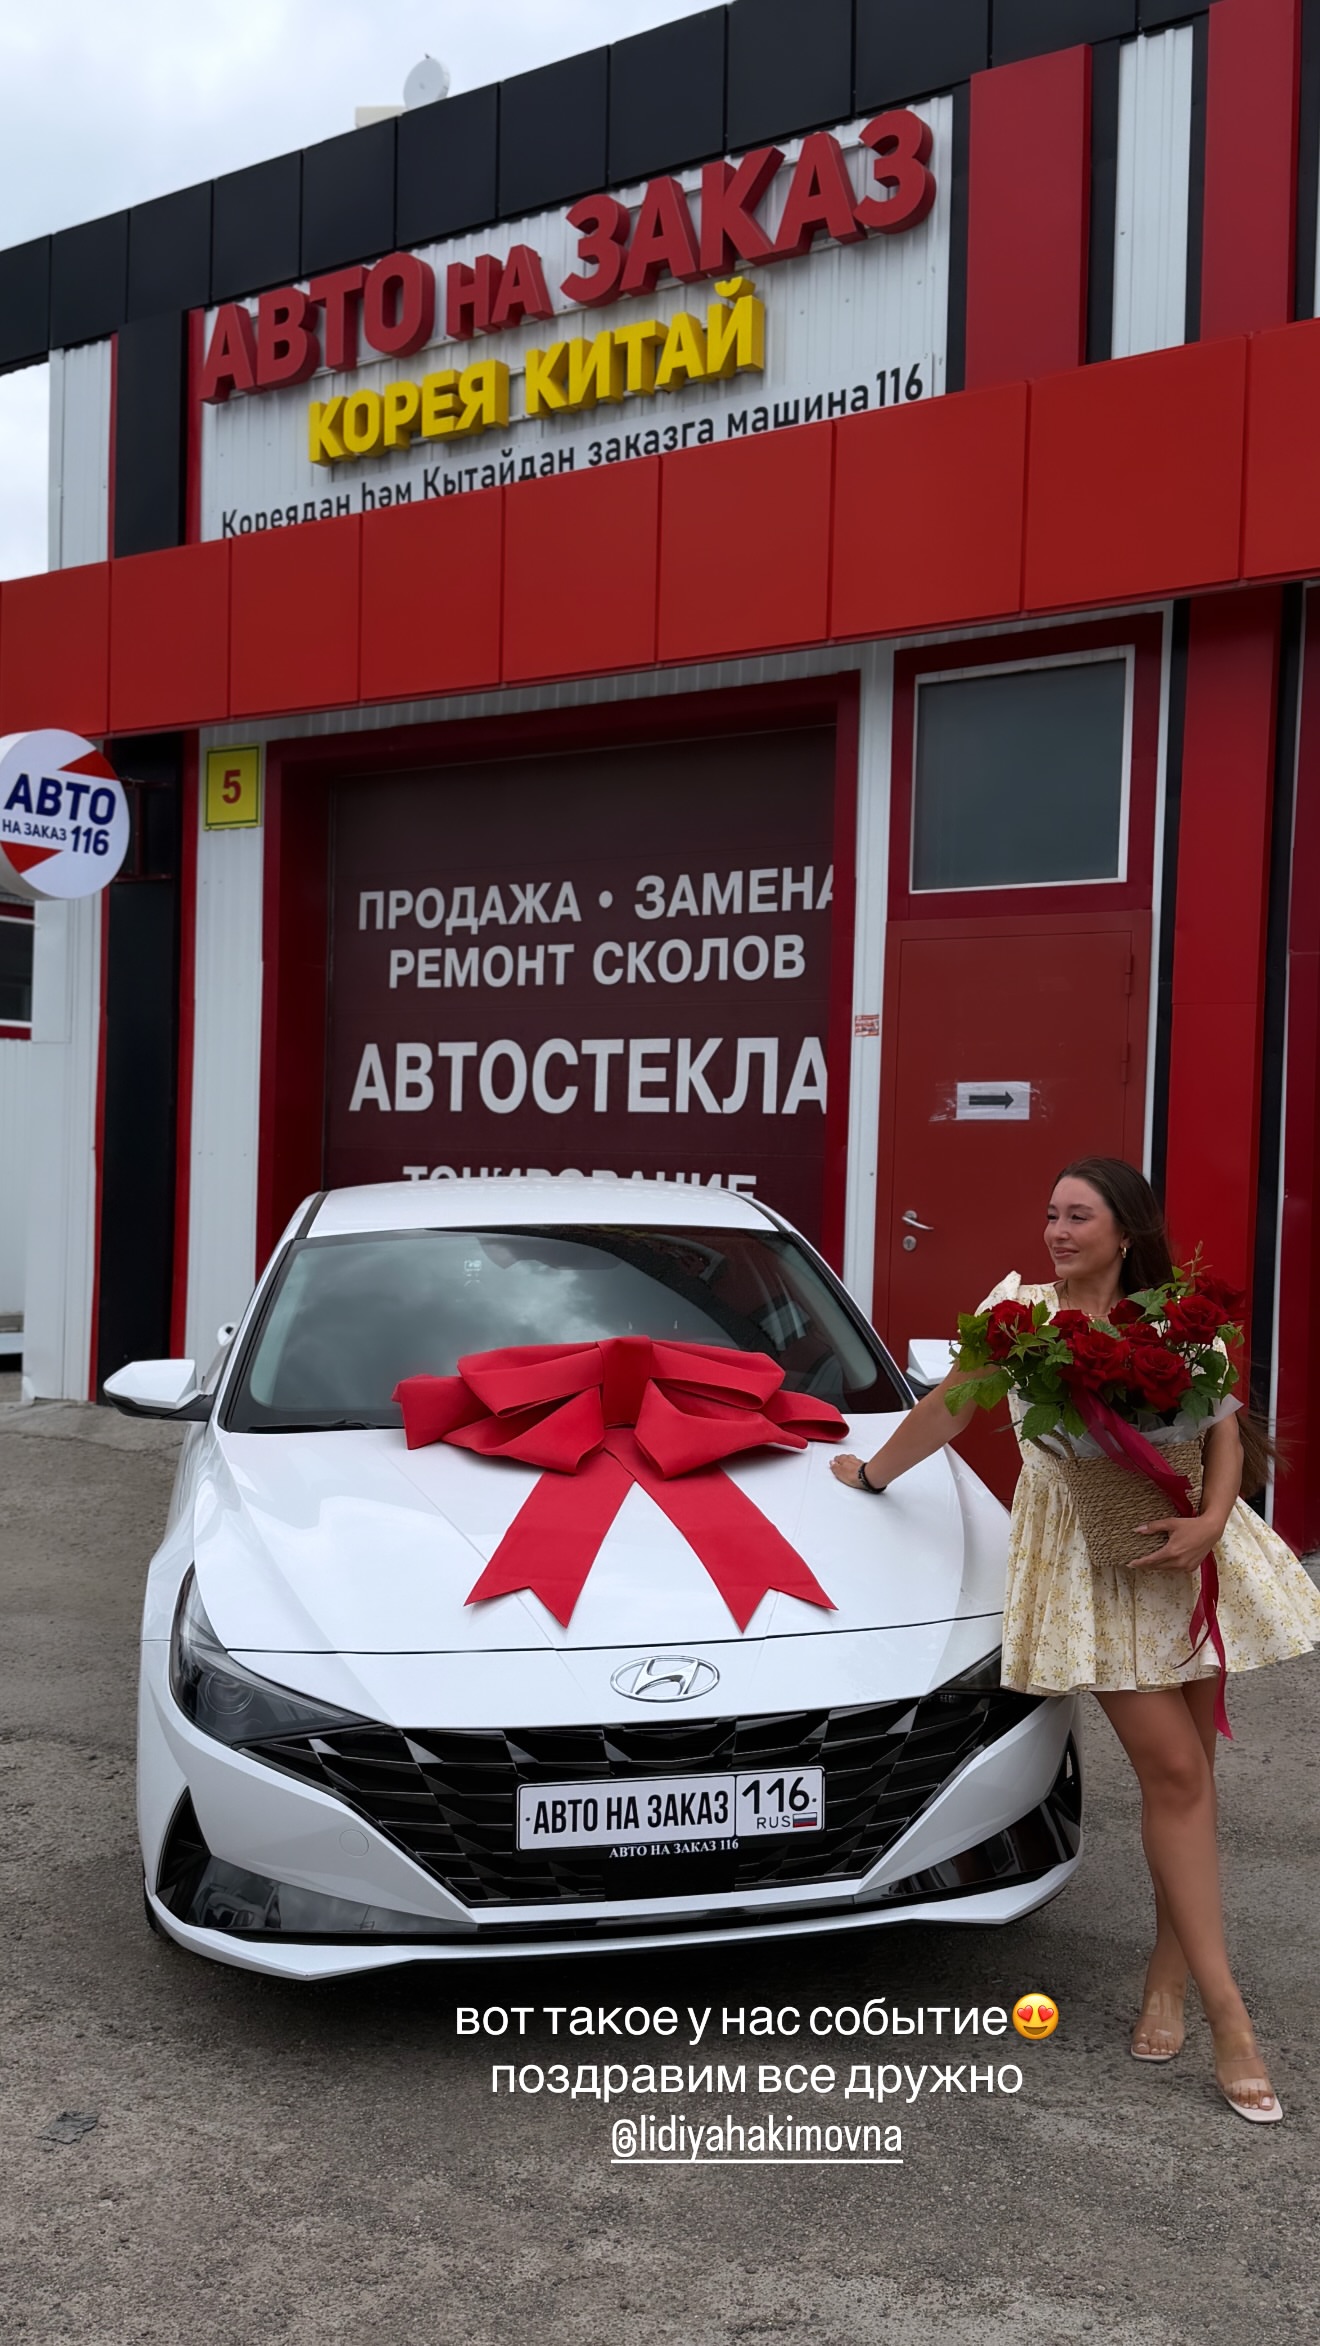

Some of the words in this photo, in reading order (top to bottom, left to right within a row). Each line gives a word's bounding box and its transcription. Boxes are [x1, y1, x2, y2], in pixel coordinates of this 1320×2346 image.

[202, 251, 435, 404] АВТО
[447, 244, 554, 341] НА
[561, 108, 936, 306] ЗАКАЗ
[309, 359, 510, 467] КОРЕЯ
[525, 276, 765, 417] КИТАЙ
[588, 417, 714, 467] заказга
[4, 773, 116, 826] АВТО
[221, 769, 242, 804] 5
[2, 818, 22, 836] НА
[24, 821, 68, 841] ЗАКАЗ
[70, 825, 110, 857] 116
[358, 880, 582, 935] ПРОДАЖА
[389, 944, 575, 989] РЕМОНТ
[592, 934, 806, 986] СКОЛОВ
[348, 1035, 828, 1116] АВТОСТЕКЛА
[533, 1798, 598, 1835] АВТО
[606, 1795, 640, 1831] НА
[647, 1790, 729, 1829] ЗАКАЗ
[741, 1776, 810, 1815] 116
[756, 1815, 792, 1830] RUS
[609, 1845, 648, 1859] АВТО
[650, 1844, 671, 1856] НА
[673, 1840, 717, 1855] ЗАКАЗ
[720, 1838, 739, 1851] 116
